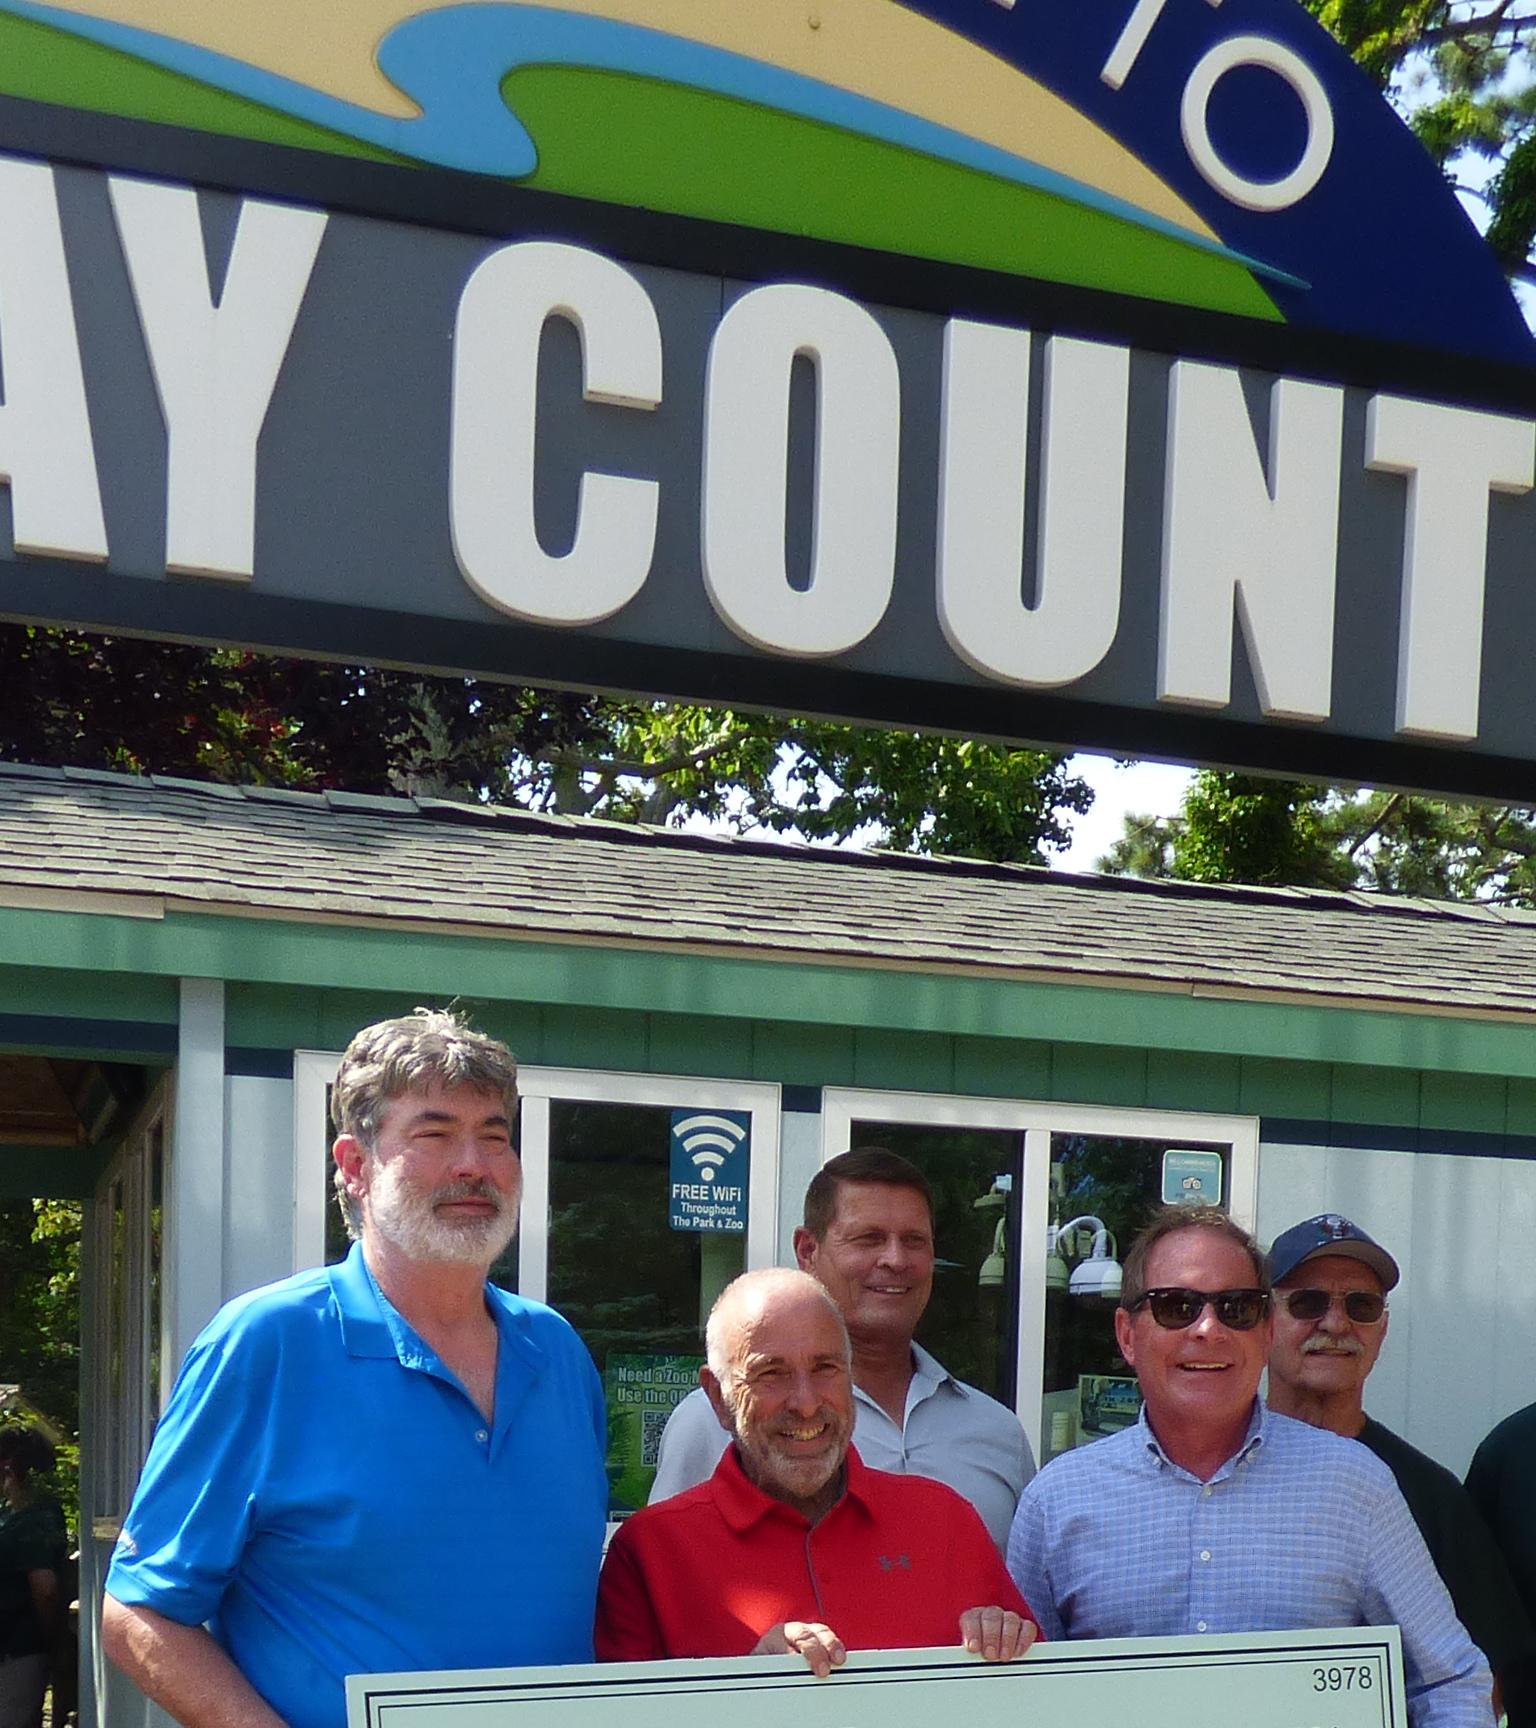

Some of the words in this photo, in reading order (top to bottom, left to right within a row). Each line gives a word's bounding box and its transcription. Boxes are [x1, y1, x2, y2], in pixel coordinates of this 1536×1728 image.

[672, 1183, 709, 1200] FREE
[681, 1201, 736, 1216] Throughout
[672, 1215, 690, 1227] The
[692, 1216, 714, 1228] Park
[724, 1218, 744, 1230] Zoo
[618, 1367, 652, 1383] Need
[655, 1370, 663, 1383] a
[665, 1369, 688, 1384] Zoo
[617, 1387, 642, 1403] Use
[644, 1388, 666, 1403] the
[1312, 1666, 1373, 1692] 3978
